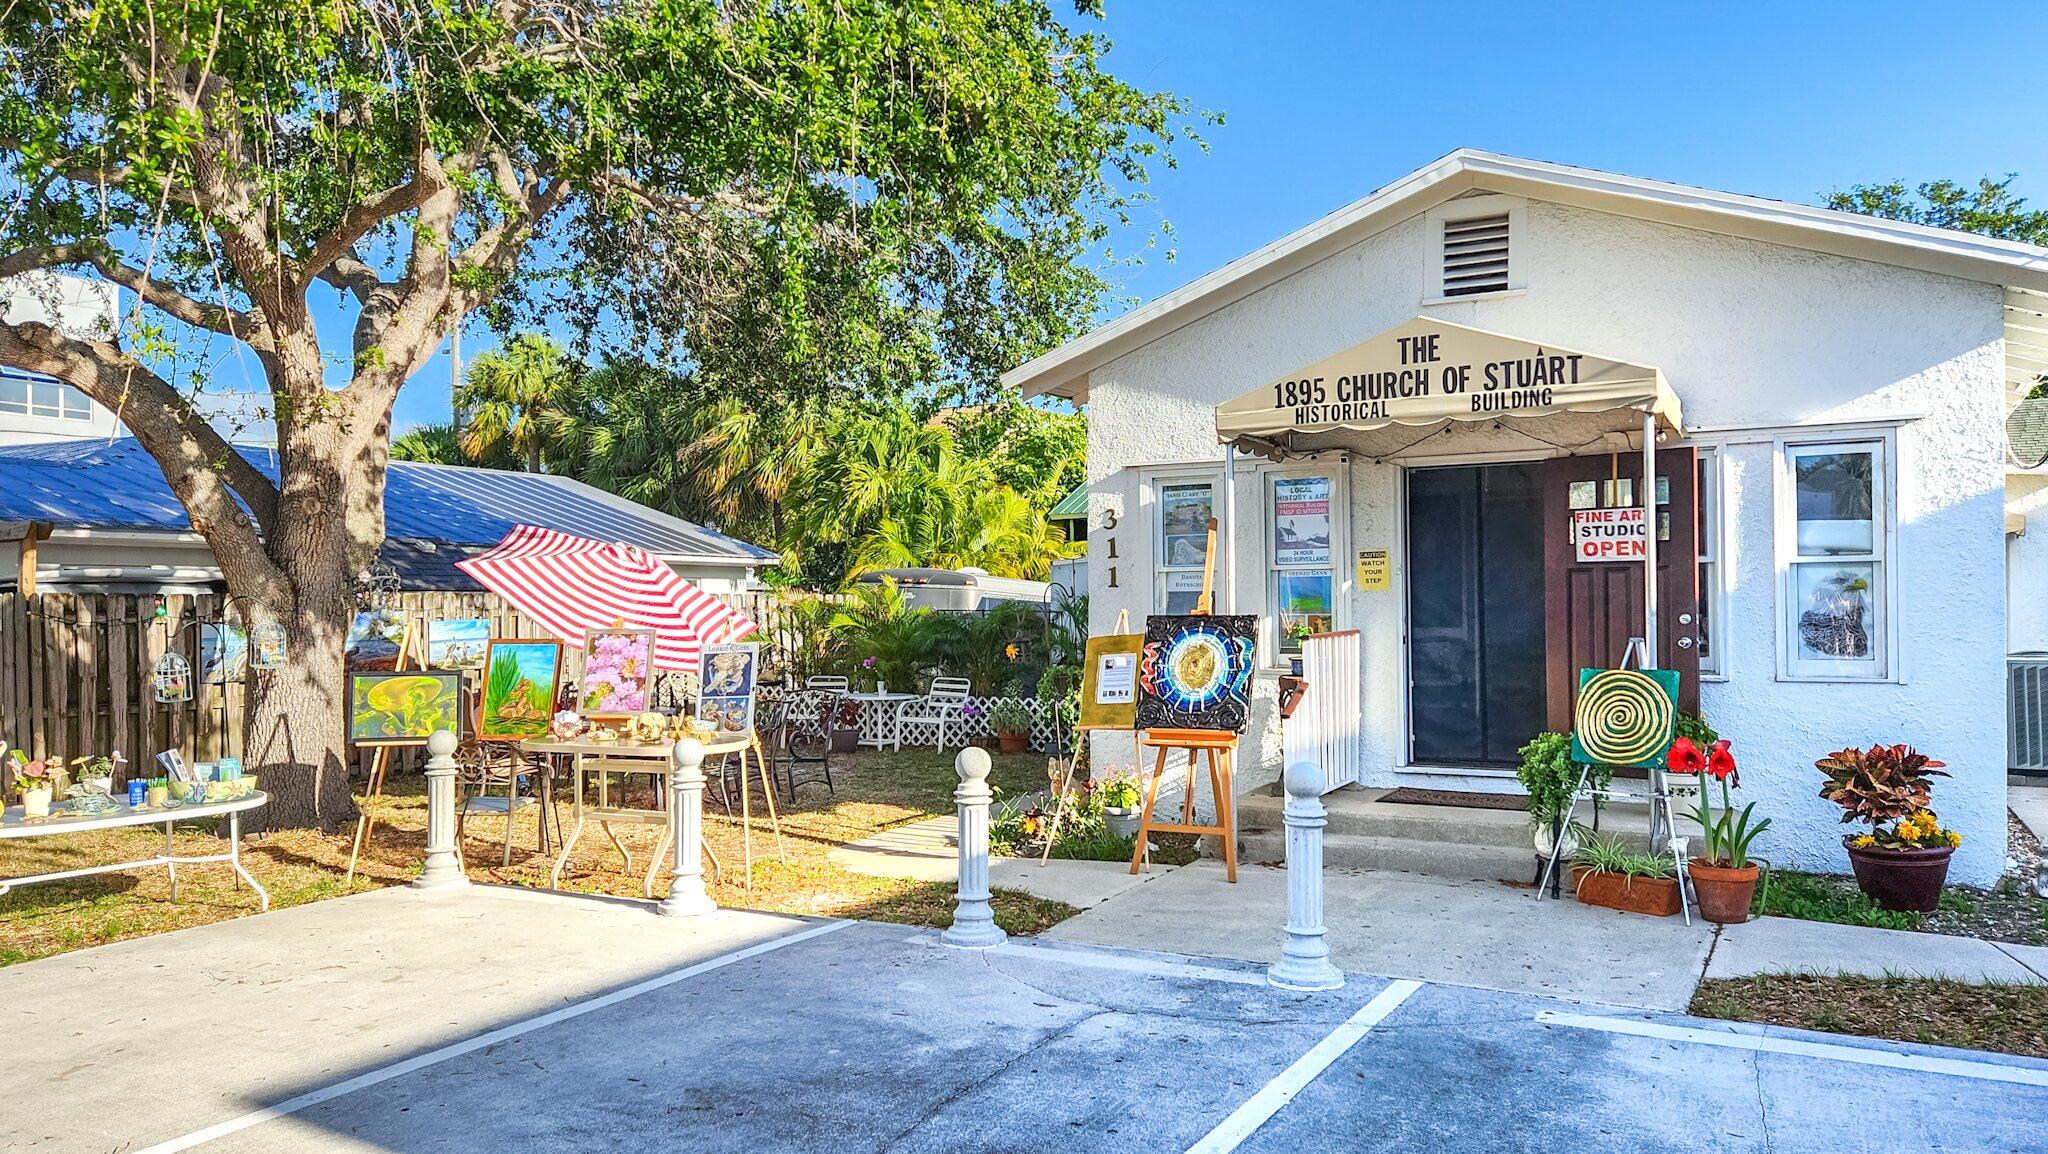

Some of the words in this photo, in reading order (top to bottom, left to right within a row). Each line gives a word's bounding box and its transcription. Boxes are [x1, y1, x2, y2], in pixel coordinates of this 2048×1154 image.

[1397, 334, 1441, 365] THE
[1274, 377, 1326, 409] 1895
[1337, 368, 1429, 403] CHURCH
[1442, 364, 1471, 395] OF
[1483, 355, 1583, 391] STUART
[1295, 400, 1390, 425] HISTORICAL
[1471, 387, 1553, 412] BUILDING
[1277, 494, 1307, 502] HISTORY
[1290, 486, 1313, 494] LOCAL
[1576, 511, 1614, 524] FINE
[1619, 509, 1645, 522] AR
[1583, 540, 1647, 557] OPEN
